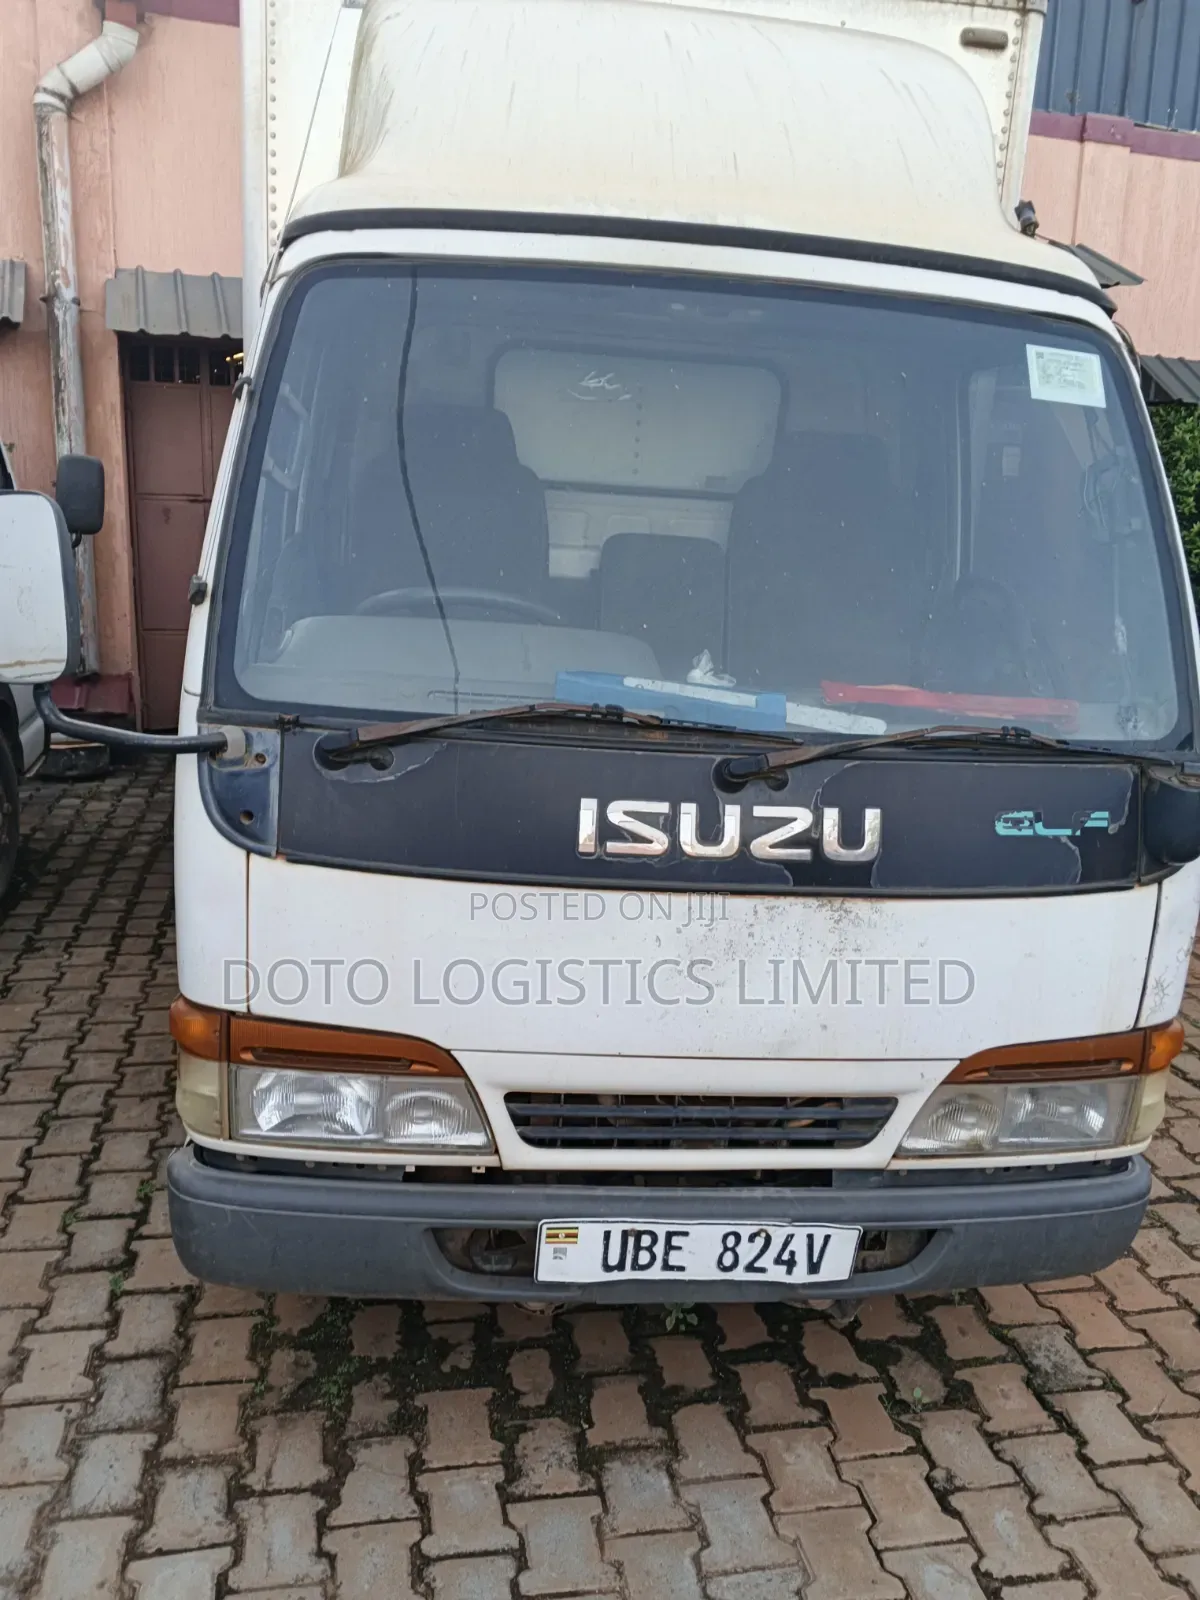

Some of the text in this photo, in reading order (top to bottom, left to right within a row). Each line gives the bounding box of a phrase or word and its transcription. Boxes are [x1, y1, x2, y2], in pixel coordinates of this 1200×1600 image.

[578, 797, 881, 863] ISUZU
[601, 1229, 832, 1276] UBE 824V
